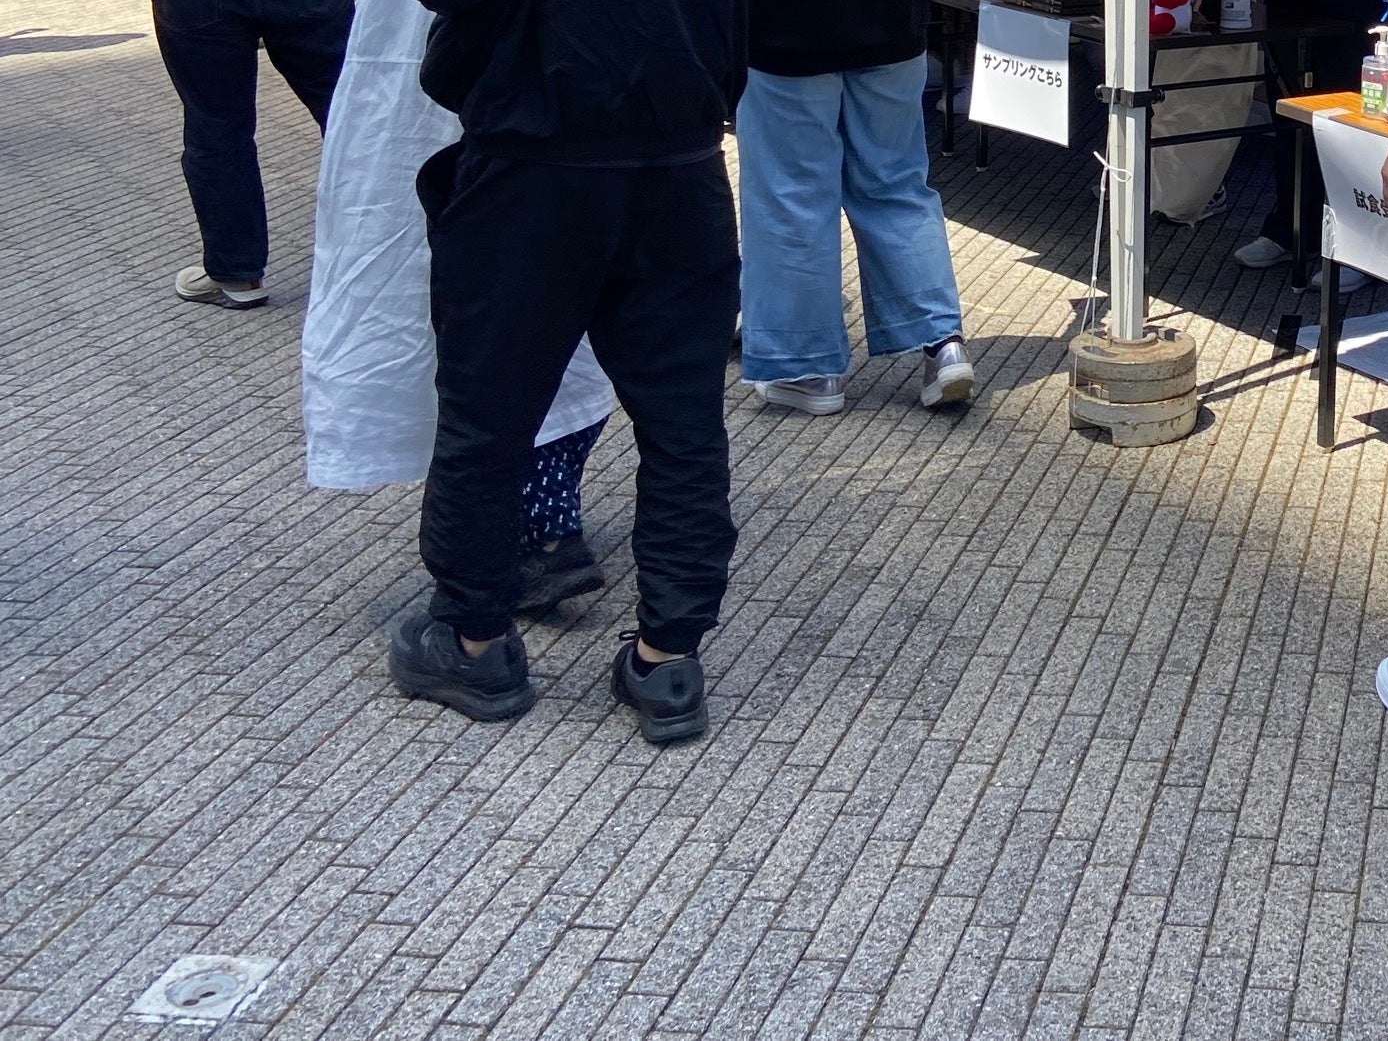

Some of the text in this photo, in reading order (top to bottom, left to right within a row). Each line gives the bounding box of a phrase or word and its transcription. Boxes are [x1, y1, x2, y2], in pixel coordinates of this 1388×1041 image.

[982, 52, 1063, 89] サンプリングこちら
